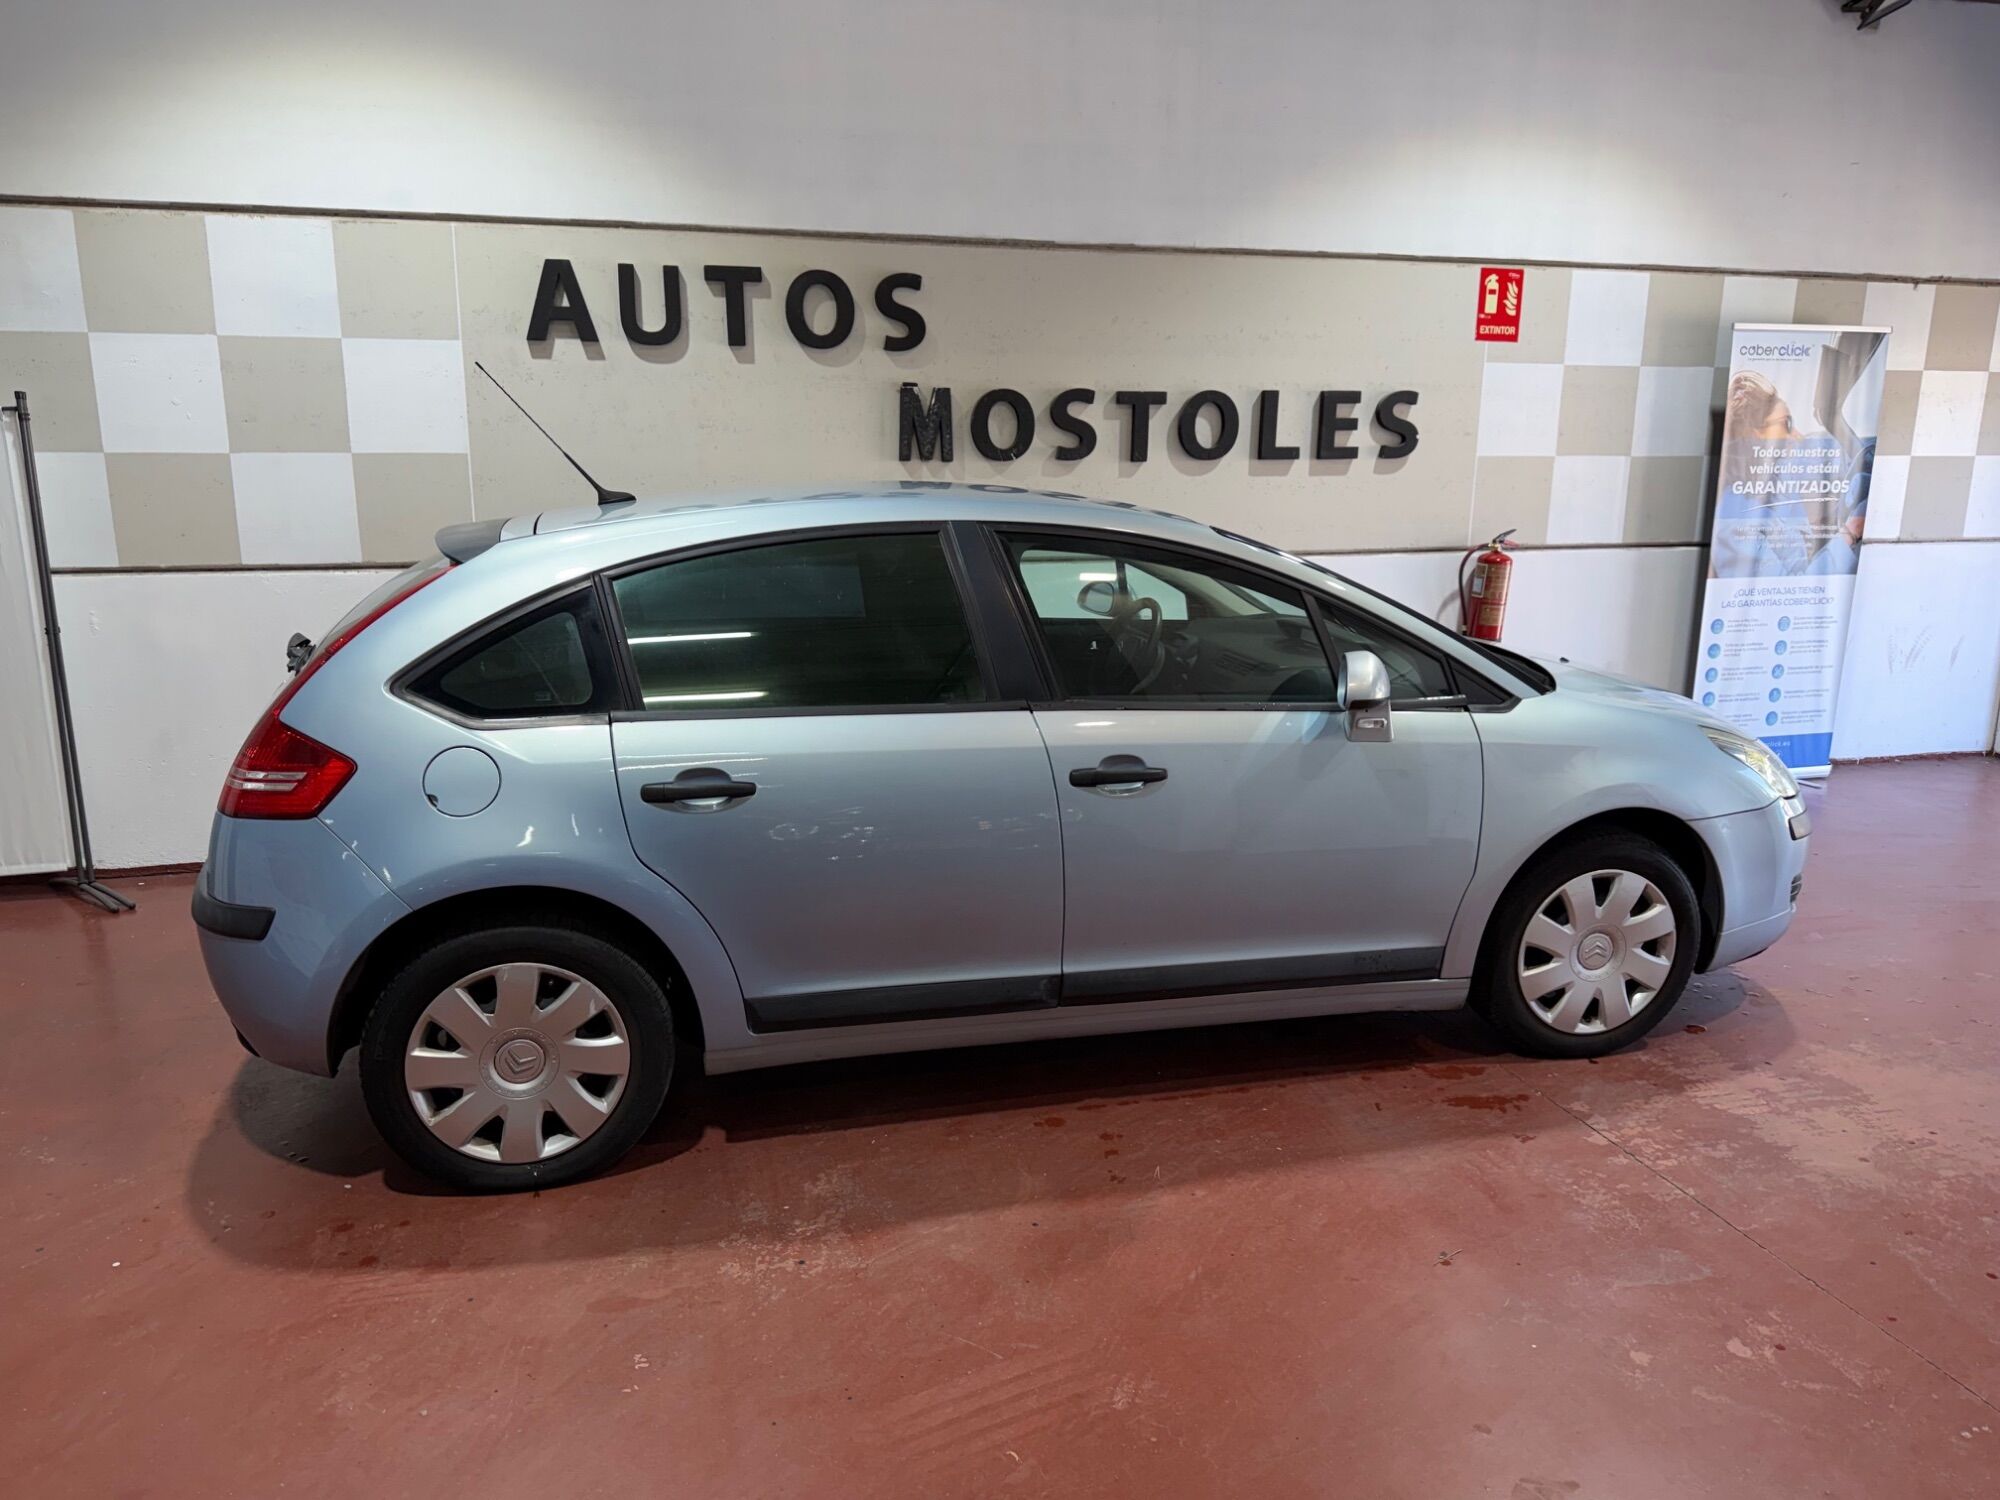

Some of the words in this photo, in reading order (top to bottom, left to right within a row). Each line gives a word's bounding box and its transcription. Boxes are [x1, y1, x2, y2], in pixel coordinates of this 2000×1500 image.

[526, 258, 927, 352] AUTOS
[1479, 325, 1516, 336] EXTINTOR
[898, 381, 1420, 462] MOSTOLES
[1752, 446, 1787, 458] Todos
[1789, 447, 1841, 458] nuestros
[1749, 462, 1805, 474] vehículos
[1806, 463, 1840, 474] están
[1732, 480, 1850, 494] GARANTIZADOS
[1757, 587, 1796, 597] VENTAJAS
[1797, 586, 1826, 596] TIENEN
[1721, 600, 1737, 609] LAS
